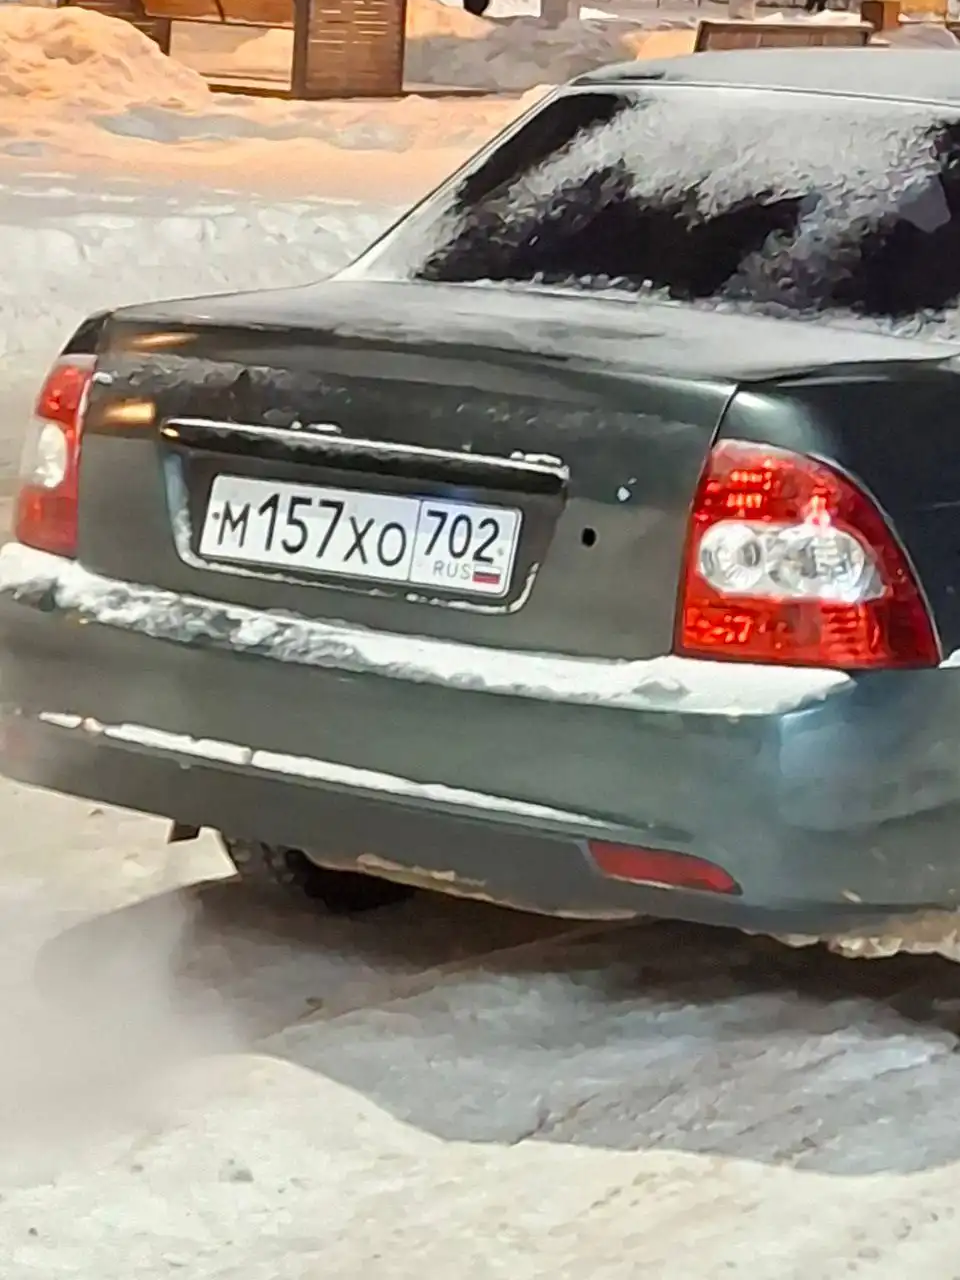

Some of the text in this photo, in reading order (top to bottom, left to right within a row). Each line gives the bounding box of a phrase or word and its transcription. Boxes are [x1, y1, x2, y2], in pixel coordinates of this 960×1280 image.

[217, 493, 500, 567] М157ХО 702
[432, 560, 471, 580] RUS
